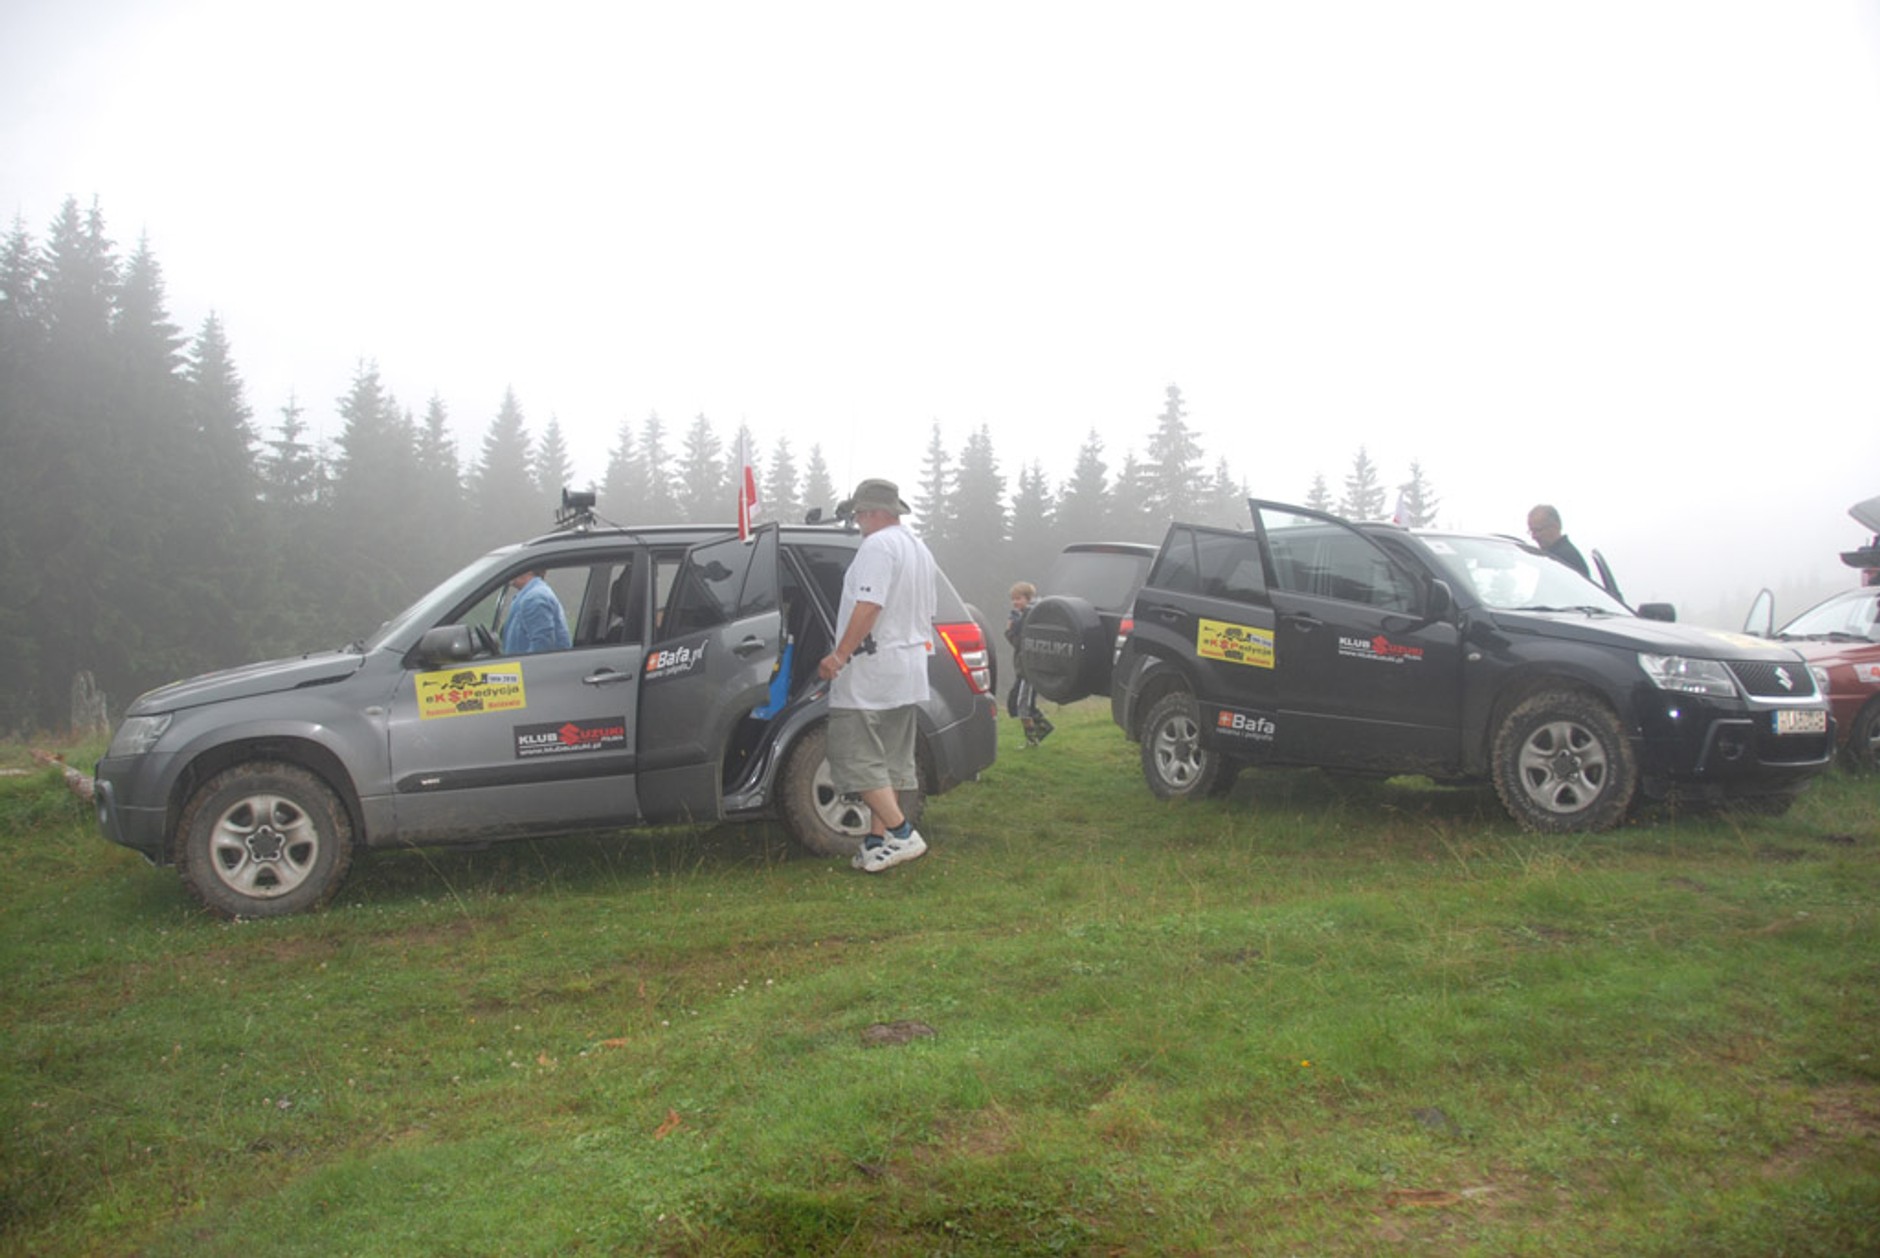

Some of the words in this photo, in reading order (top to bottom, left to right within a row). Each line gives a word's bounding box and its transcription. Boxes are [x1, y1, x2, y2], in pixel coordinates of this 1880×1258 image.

[1339, 637, 1371, 648] KLUB
[1232, 713, 1275, 734] Bafa
[518, 732, 558, 745] KLUB
